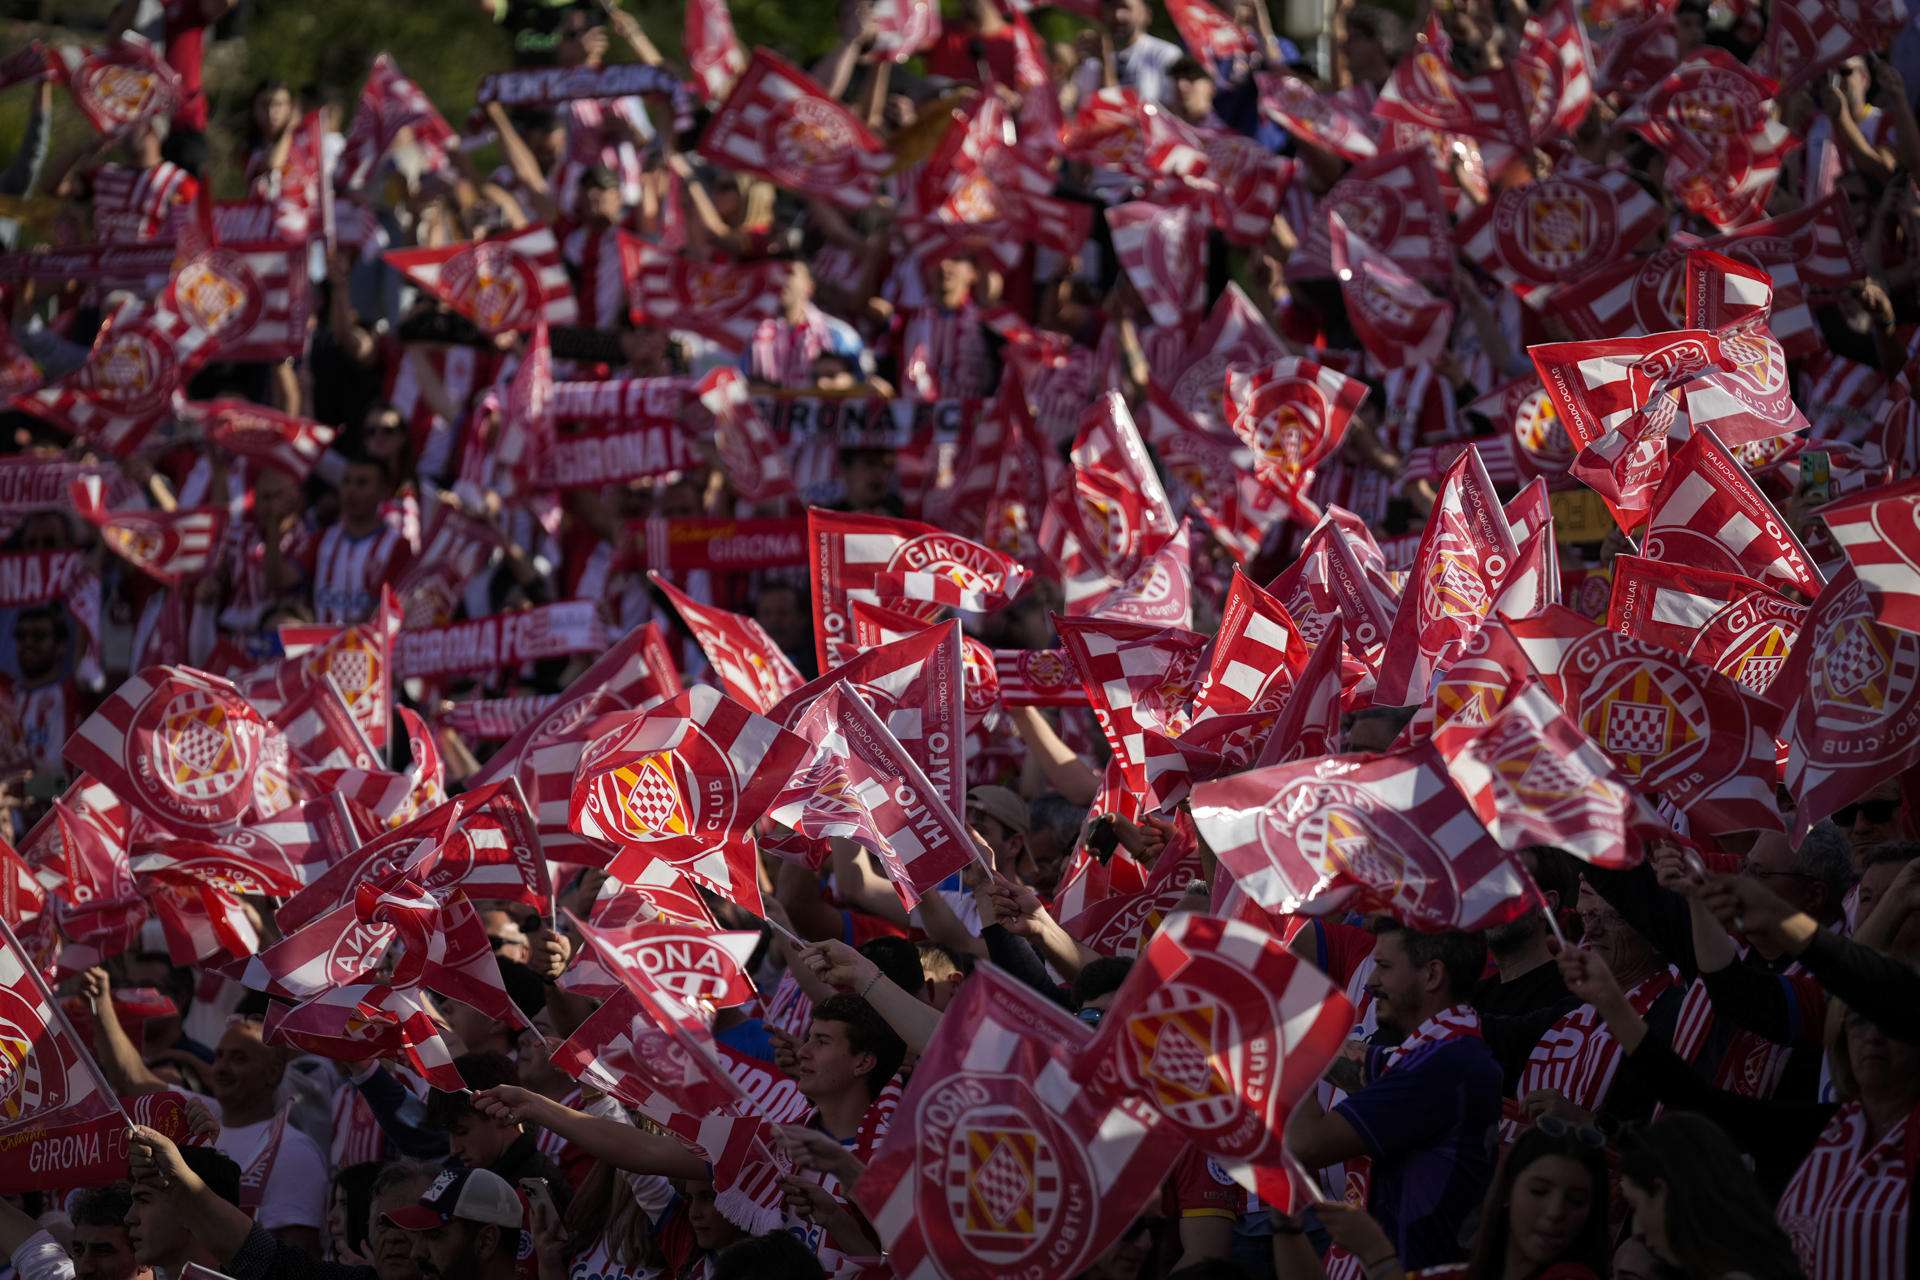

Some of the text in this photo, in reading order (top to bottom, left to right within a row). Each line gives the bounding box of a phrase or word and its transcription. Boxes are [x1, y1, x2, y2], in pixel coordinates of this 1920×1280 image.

[905, 538, 1006, 594] GIRONA
[1624, 579, 1638, 615] OCULAR
[706, 779, 725, 831] CLUB
[28, 1132, 101, 1173] GIRONA
